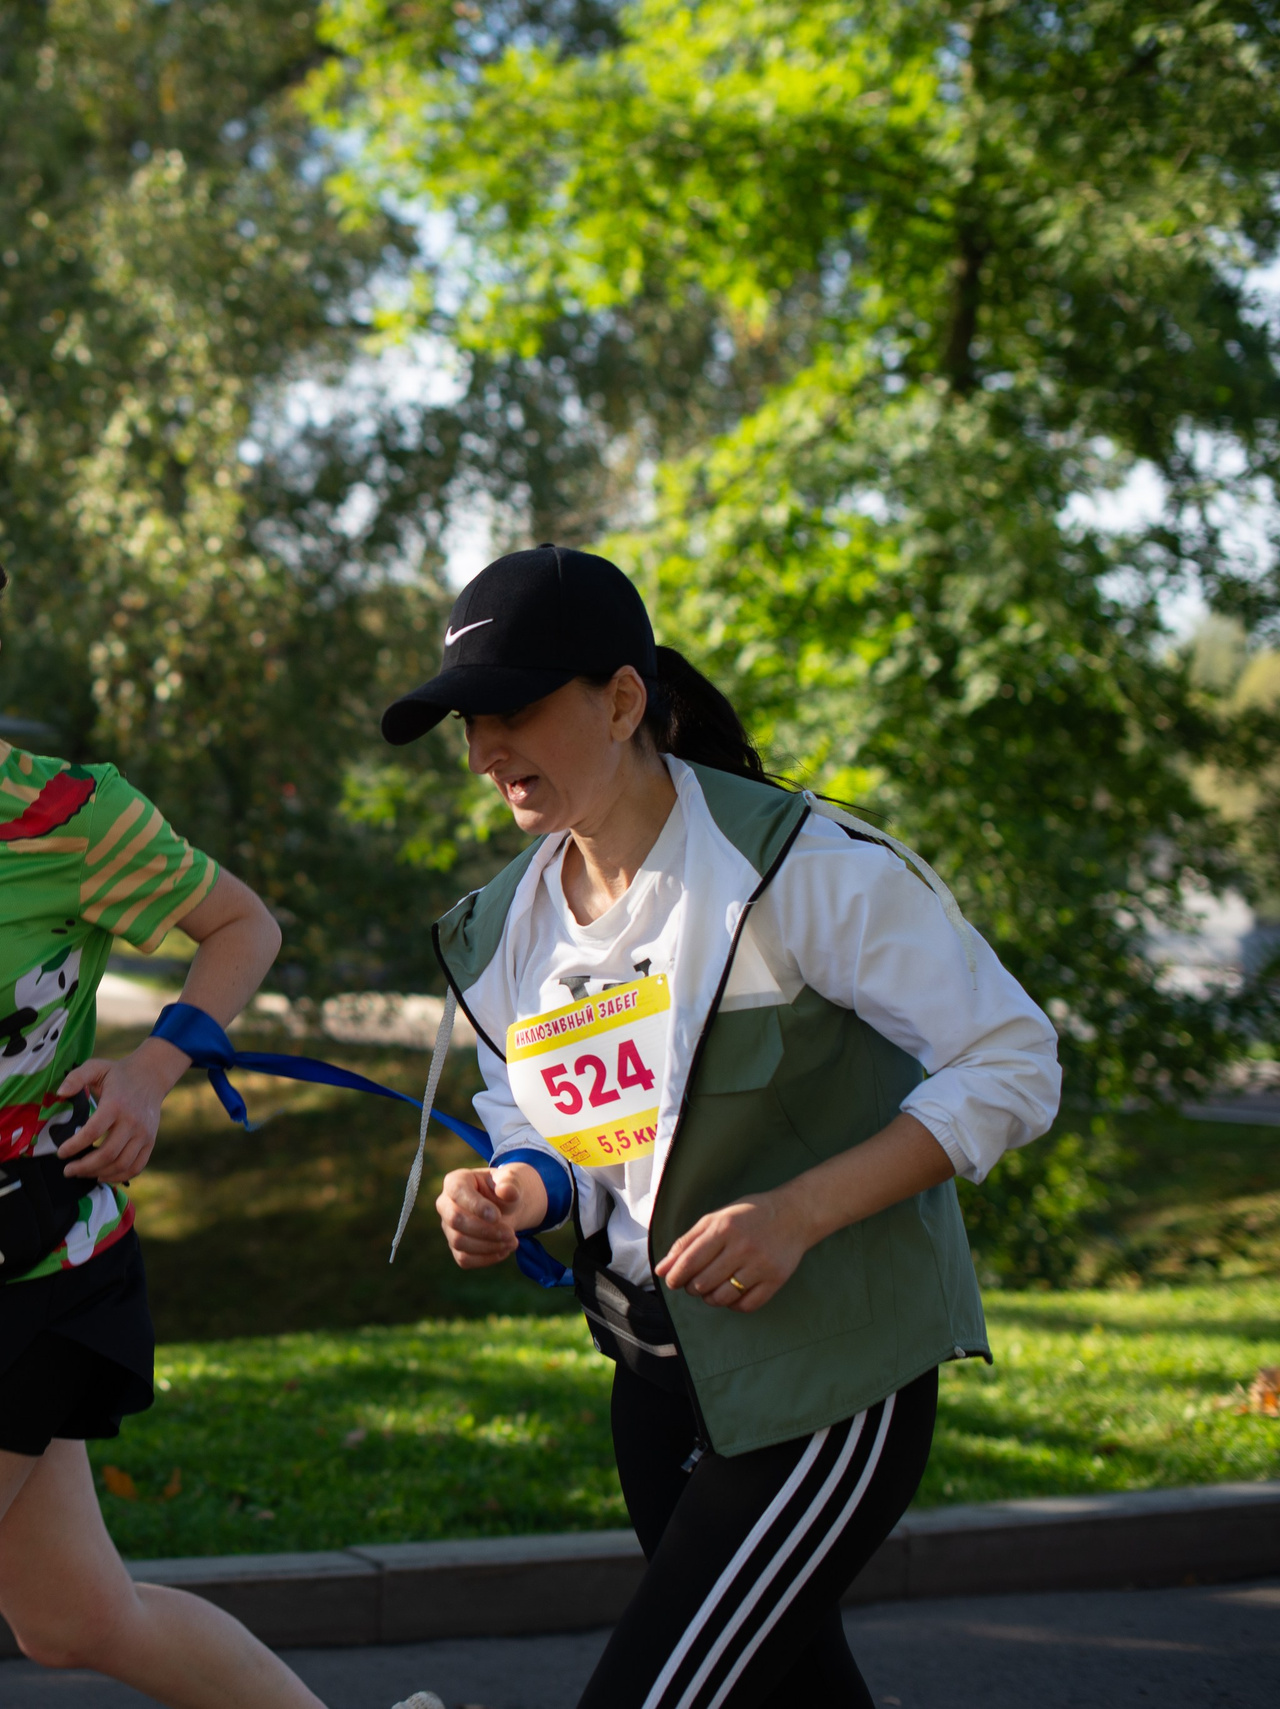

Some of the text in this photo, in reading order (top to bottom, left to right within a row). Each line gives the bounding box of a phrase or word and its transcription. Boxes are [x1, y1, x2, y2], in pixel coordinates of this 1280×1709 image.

[515, 990, 639, 1047] ИНКЛЮЗИВНЫЙ ЗАБЕГ
[540, 1039, 655, 1115] 524
[597, 1129, 631, 1156] 5,5
